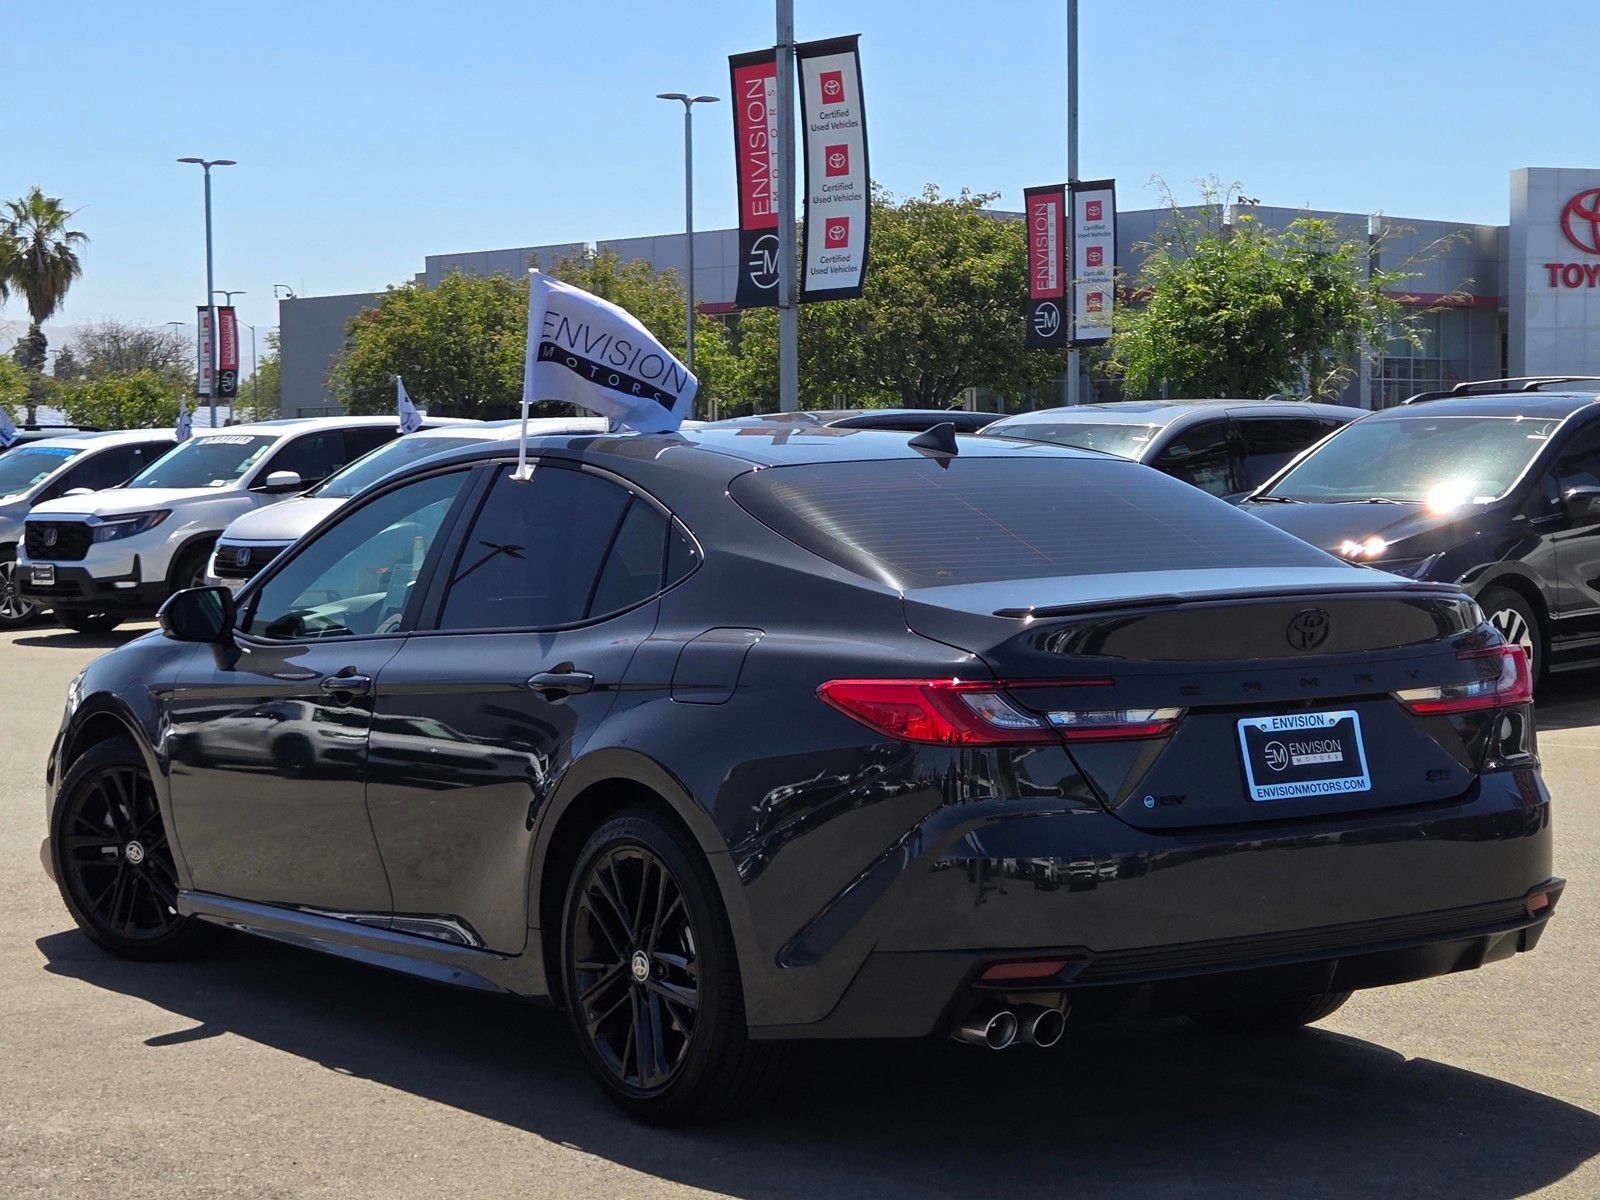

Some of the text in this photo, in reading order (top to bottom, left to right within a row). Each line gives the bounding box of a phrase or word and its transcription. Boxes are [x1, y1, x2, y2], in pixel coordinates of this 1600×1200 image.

[819, 109, 850, 120] Certified
[811, 120, 859, 132] Used Vehicles
[746, 78, 770, 216] ENVISION
[768, 89, 779, 202] MOTORS
[822, 182, 854, 192] Certified
[813, 193, 863, 204] Used Vehicles
[1034, 203, 1049, 291] ENVISION
[820, 254, 851, 264] Certified
[810, 264, 858, 276] Used Vehicles
[541, 311, 688, 394] ENVISION
[542, 346, 663, 402] MOTORS
[1272, 714, 1325, 730] ENVISION
[1289, 739, 1342, 756] ENVISION
[1257, 778, 1367, 798] ENVISIONMOTORS.COM
